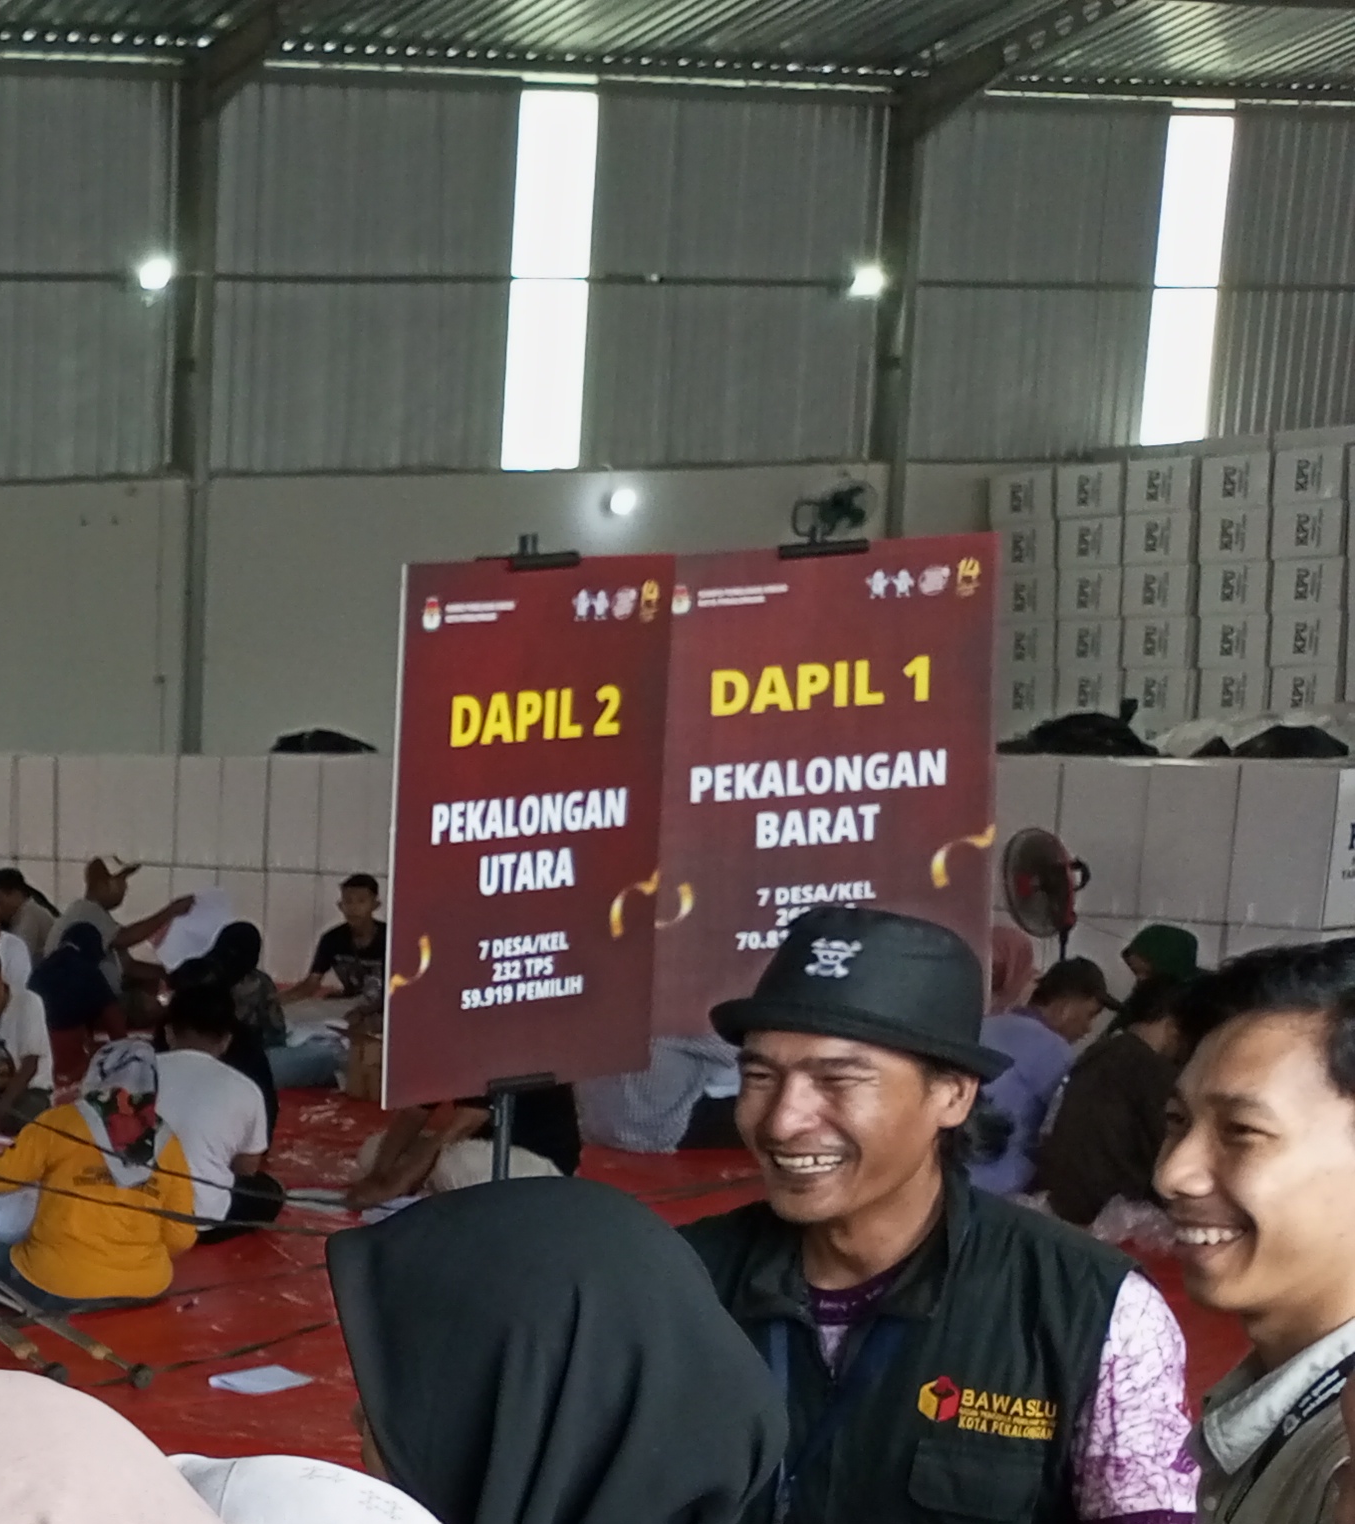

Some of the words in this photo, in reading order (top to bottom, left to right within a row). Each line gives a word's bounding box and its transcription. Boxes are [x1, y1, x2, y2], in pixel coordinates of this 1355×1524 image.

[710, 657, 885, 717] DAPIL
[903, 655, 931, 702] 1
[450, 688, 583, 748] DAPIL
[594, 685, 622, 736] 2
[690, 749, 948, 803] PEKALONGAN
[431, 788, 628, 846] PEKALONGAN
[755, 804, 881, 850] BARAT
[479, 849, 575, 897] UTARA
[756, 887, 771, 907] 7
[774, 880, 877, 905] DESA/KEL
[478, 939, 490, 961] 7
[491, 931, 570, 959] DESA/KEL
[492, 960, 522, 983] 232
[524, 955, 555, 978] TPS
[460, 983, 514, 1010] 59.919
[515, 974, 584, 1002] PEMILIH
[961, 1388, 1058, 1418] BAWASLU
[958, 1416, 988, 1433] KOTA
